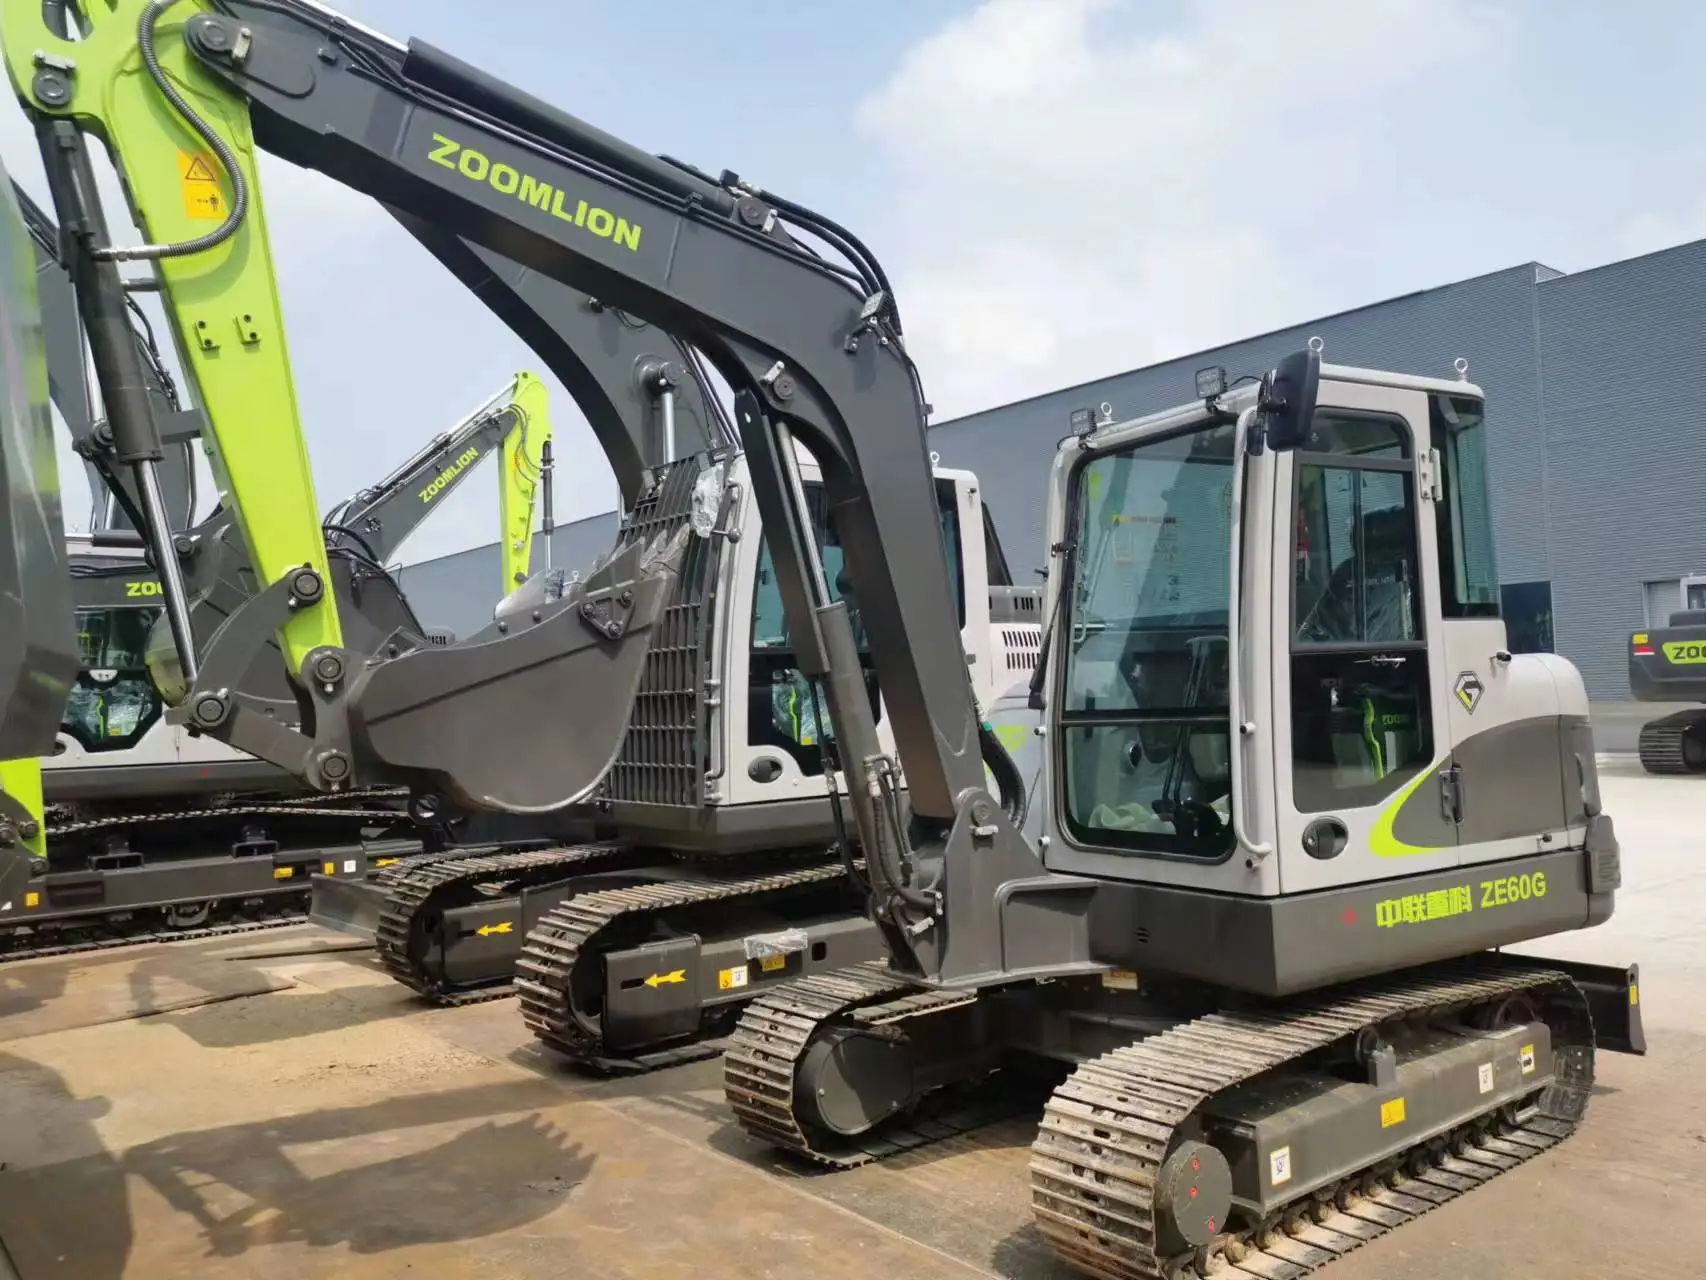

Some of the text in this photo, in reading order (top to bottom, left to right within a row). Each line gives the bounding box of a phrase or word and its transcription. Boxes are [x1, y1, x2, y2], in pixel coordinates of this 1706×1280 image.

[427, 132, 642, 252] ZOOMLION
[418, 446, 479, 503] ZOOMLION
[1376, 872, 1546, 928] 中联重科 ZE60G
